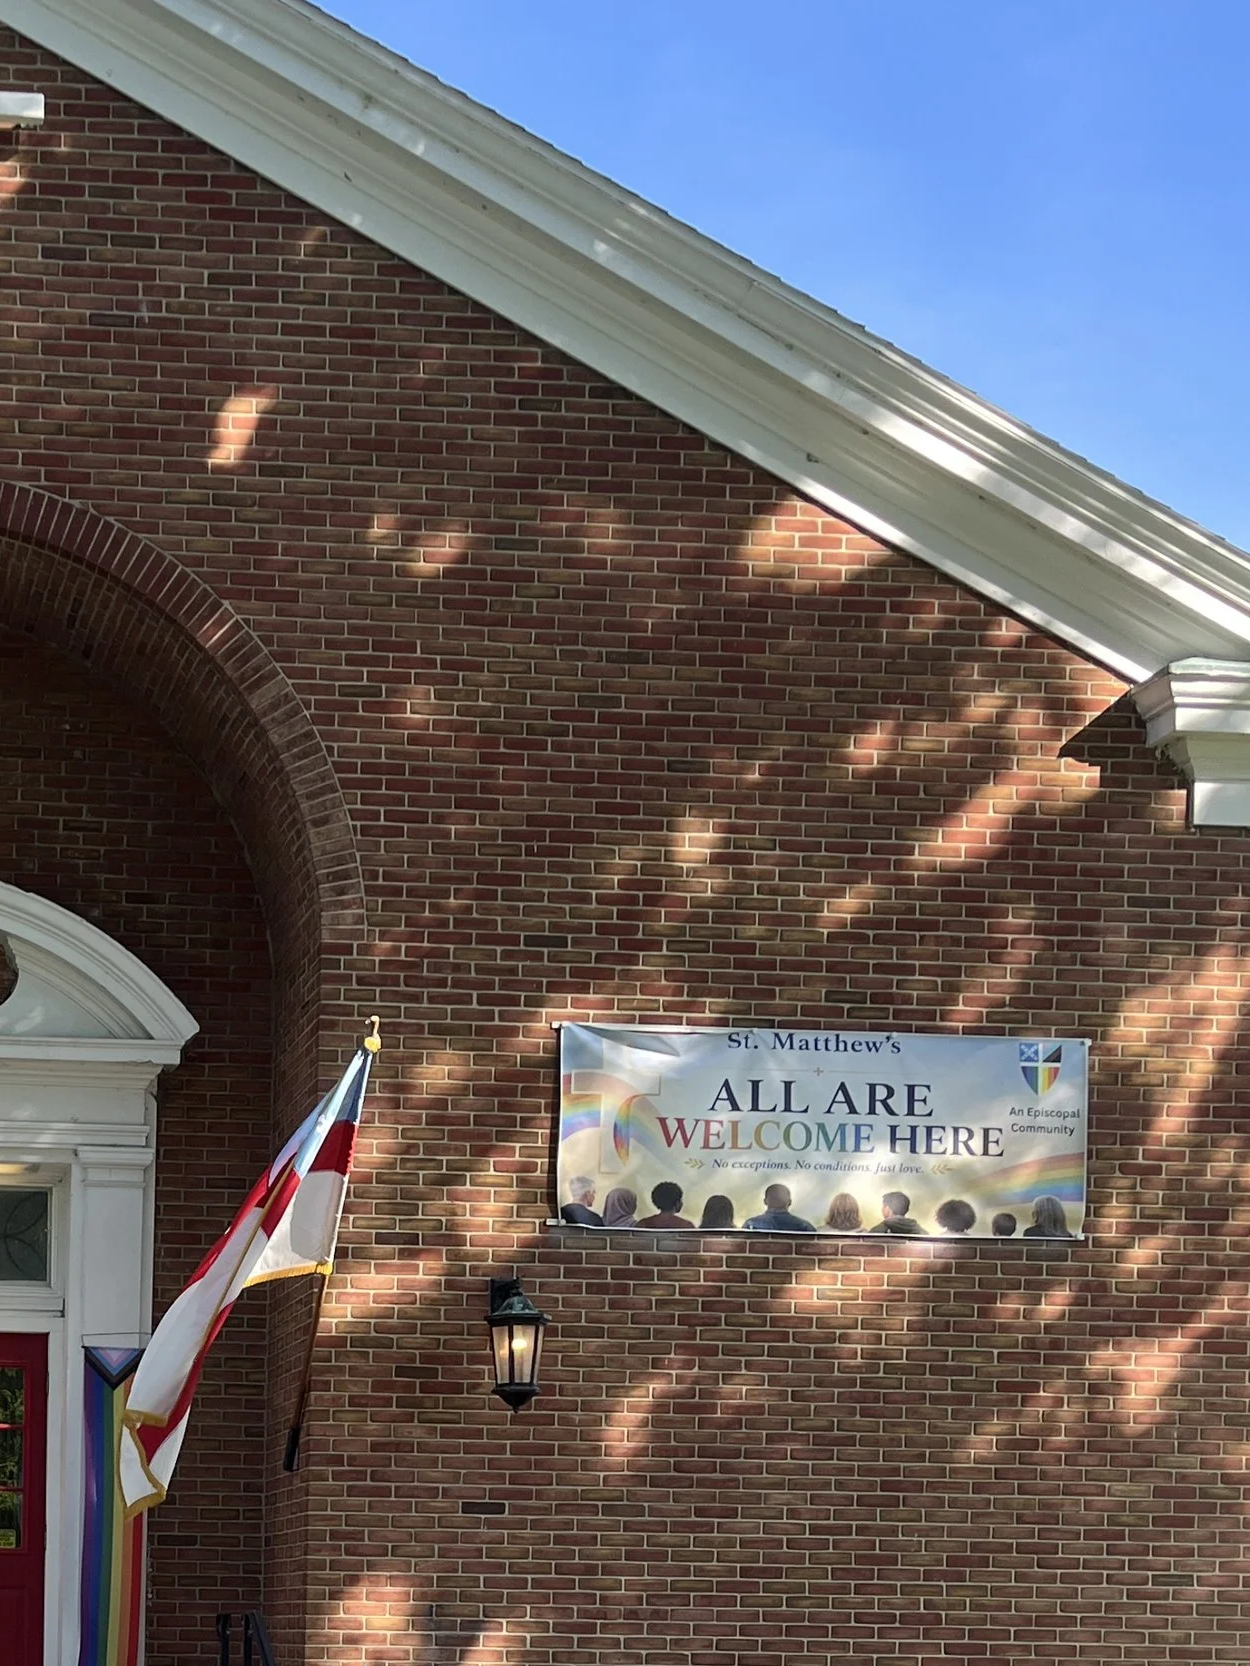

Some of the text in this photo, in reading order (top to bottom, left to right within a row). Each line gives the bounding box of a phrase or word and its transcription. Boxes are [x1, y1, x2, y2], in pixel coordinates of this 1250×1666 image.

[727, 1032, 901, 1054] St. Matthew's
[708, 1078, 934, 1117] ALL ARE
[1009, 1107, 1081, 1120] An Episcopal
[656, 1116, 1005, 1157] WELCOME HERE
[1011, 1123, 1076, 1136] Community
[712, 1159, 924, 1174] No exceptions. No conditions. Just love.
